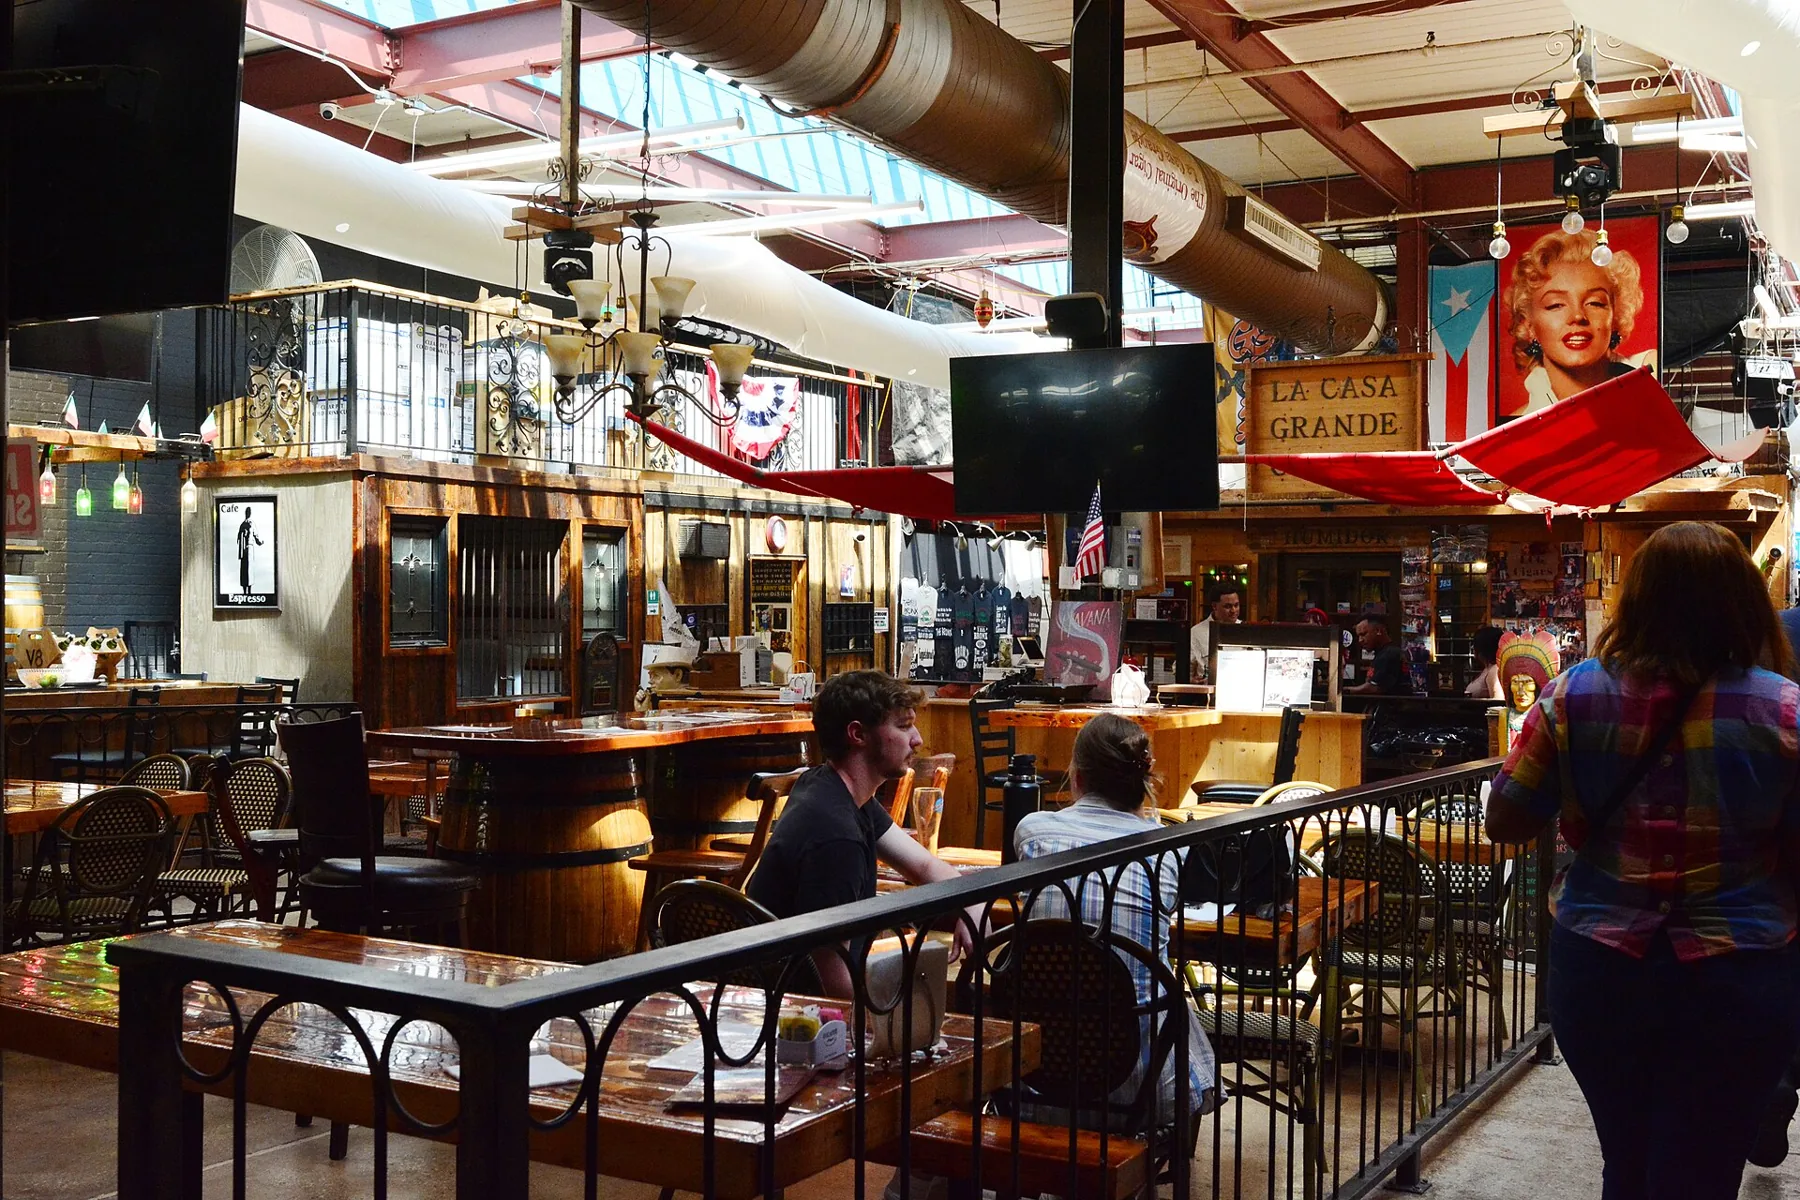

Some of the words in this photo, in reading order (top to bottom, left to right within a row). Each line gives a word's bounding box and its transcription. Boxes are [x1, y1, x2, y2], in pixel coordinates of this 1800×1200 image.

[1129, 152, 1153, 180] Cigar
[1154, 167, 1189, 201] Original
[1190, 187, 1205, 210] The
[1270, 379, 1309, 402] LA
[1320, 374, 1398, 400] CASA
[1270, 412, 1398, 441] GRANDE
[221, 504, 239, 514] Cafe
[1283, 528, 1389, 546] HUMIDOR
[1513, 566, 1553, 577] Cigars
[228, 593, 266, 605] Espresso
